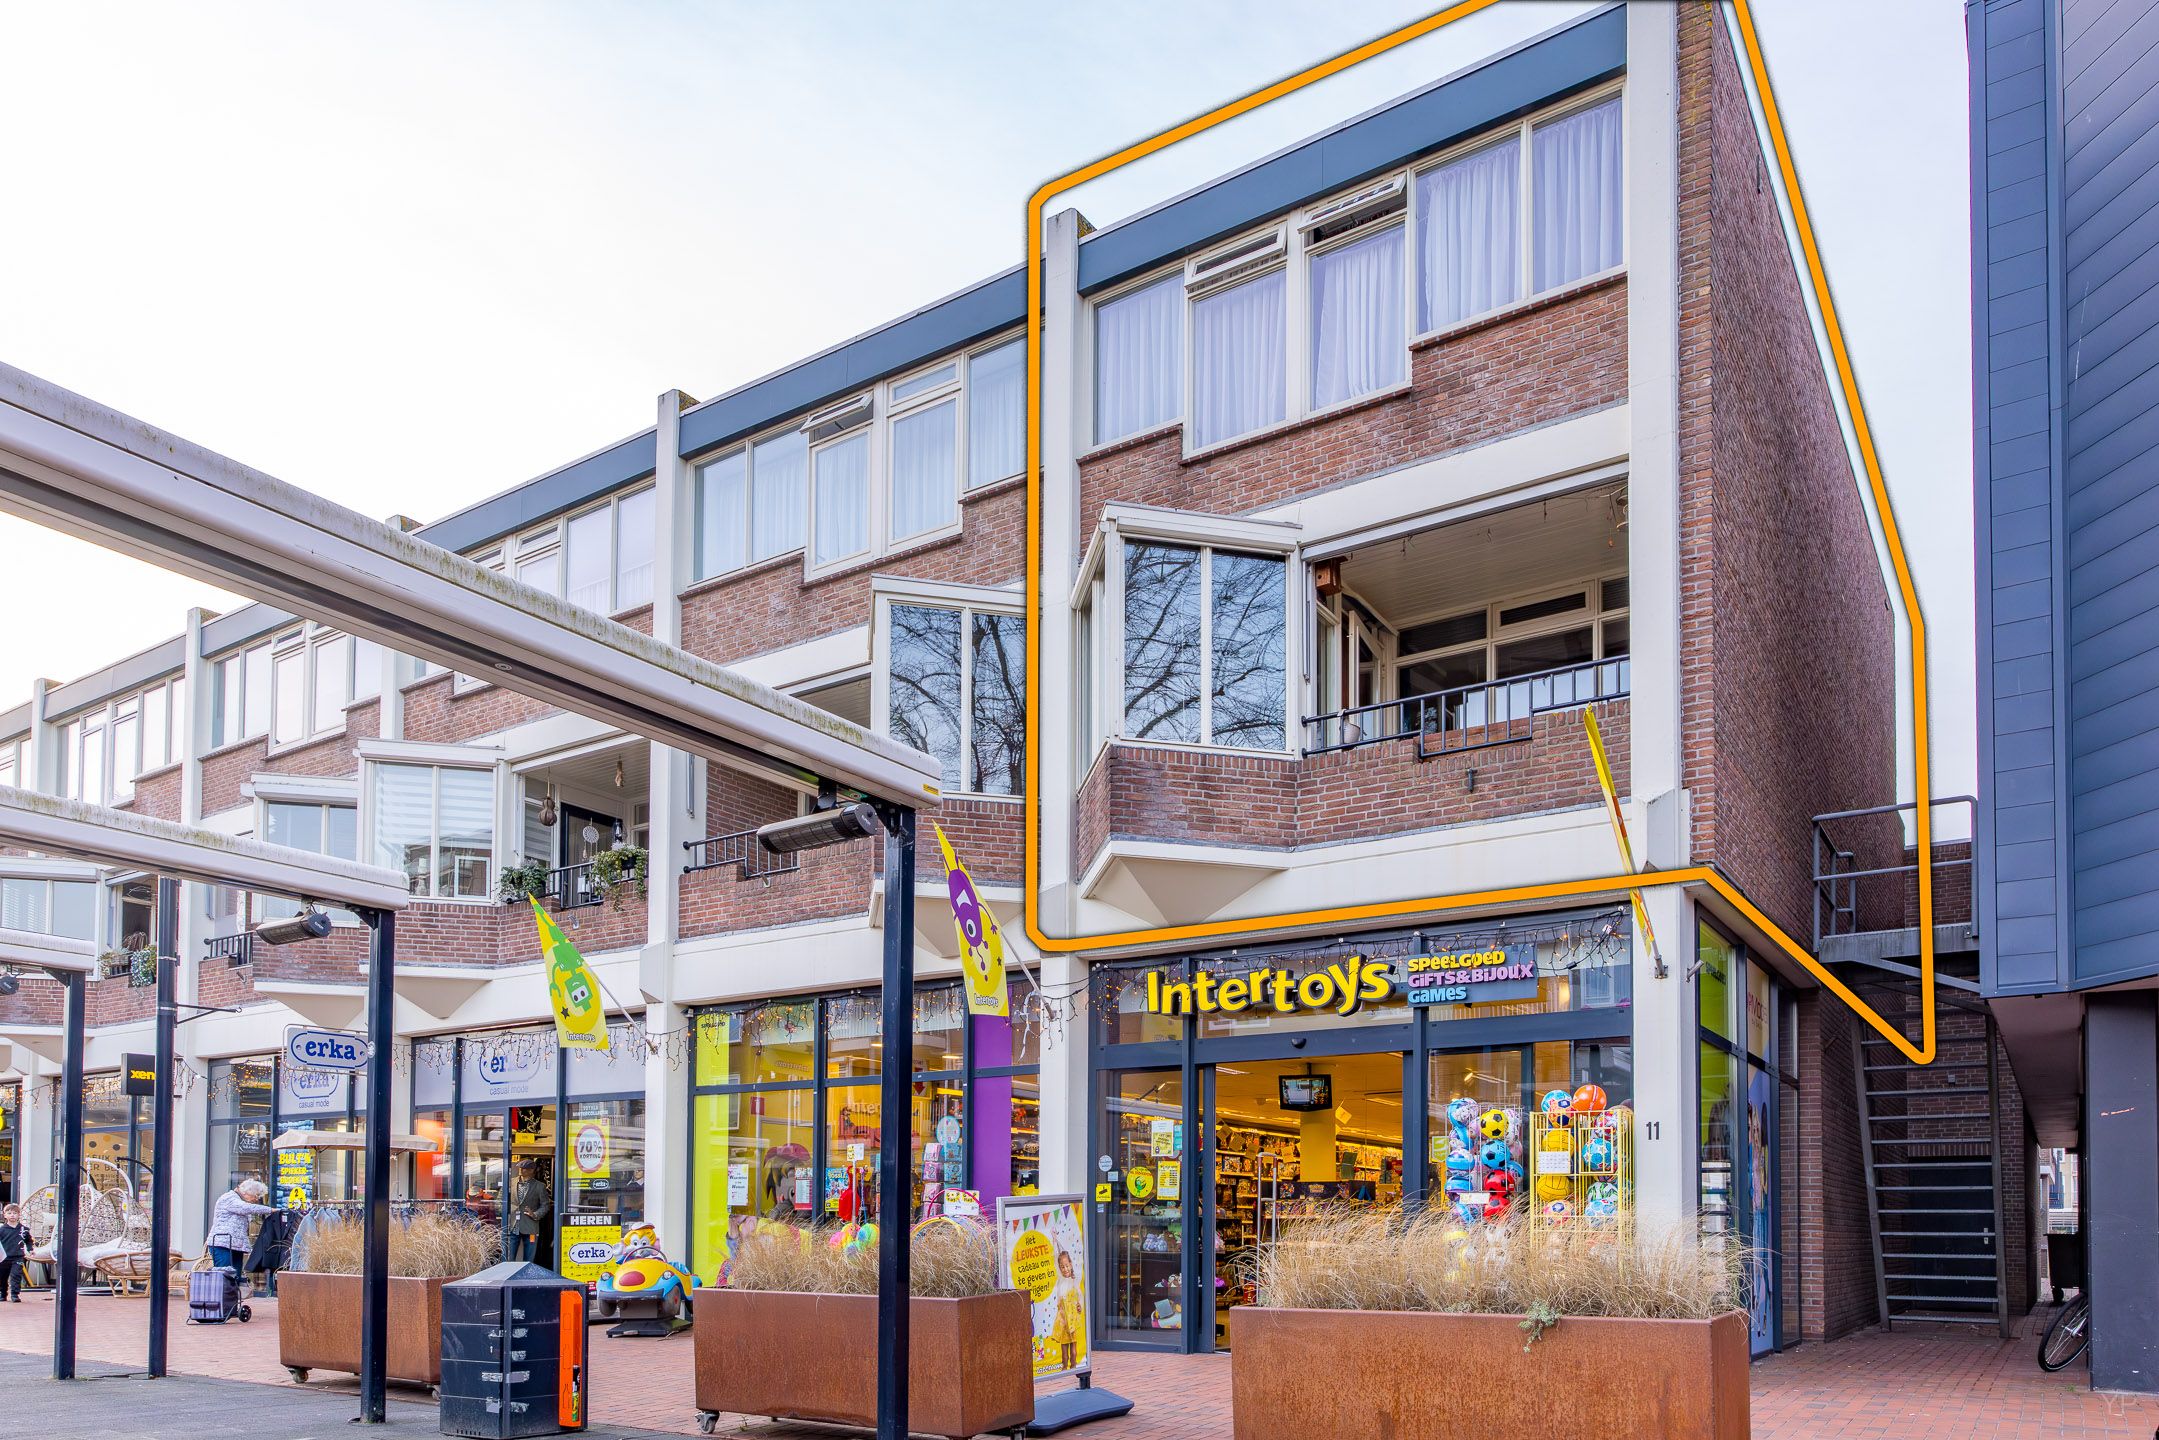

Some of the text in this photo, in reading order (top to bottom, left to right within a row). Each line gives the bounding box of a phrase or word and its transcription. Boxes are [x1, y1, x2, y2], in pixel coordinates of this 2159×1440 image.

[1147, 955, 1394, 1016] Intertoys
[566, 1030, 596, 1043] Intertoys
[305, 1038, 356, 1060] erka
[130, 1069, 155, 1080] xen
[489, 1085, 510, 1095] casual
[298, 1098, 329, 1109] casual mode
[1645, 1121, 1660, 1140] 11
[579, 1140, 603, 1153] 70%
[570, 1215, 612, 1225] HEREN
[1025, 1235, 1036, 1246] Het
[577, 1246, 606, 1258] erka
[1016, 1244, 1049, 1262] LEUKSTE
[1018, 1259, 1051, 1273] cadeau om
[1017, 1276, 1026, 1285] te
[1026, 1273, 1047, 1287] geven
[1025, 1281, 1050, 1297] rijgen!
